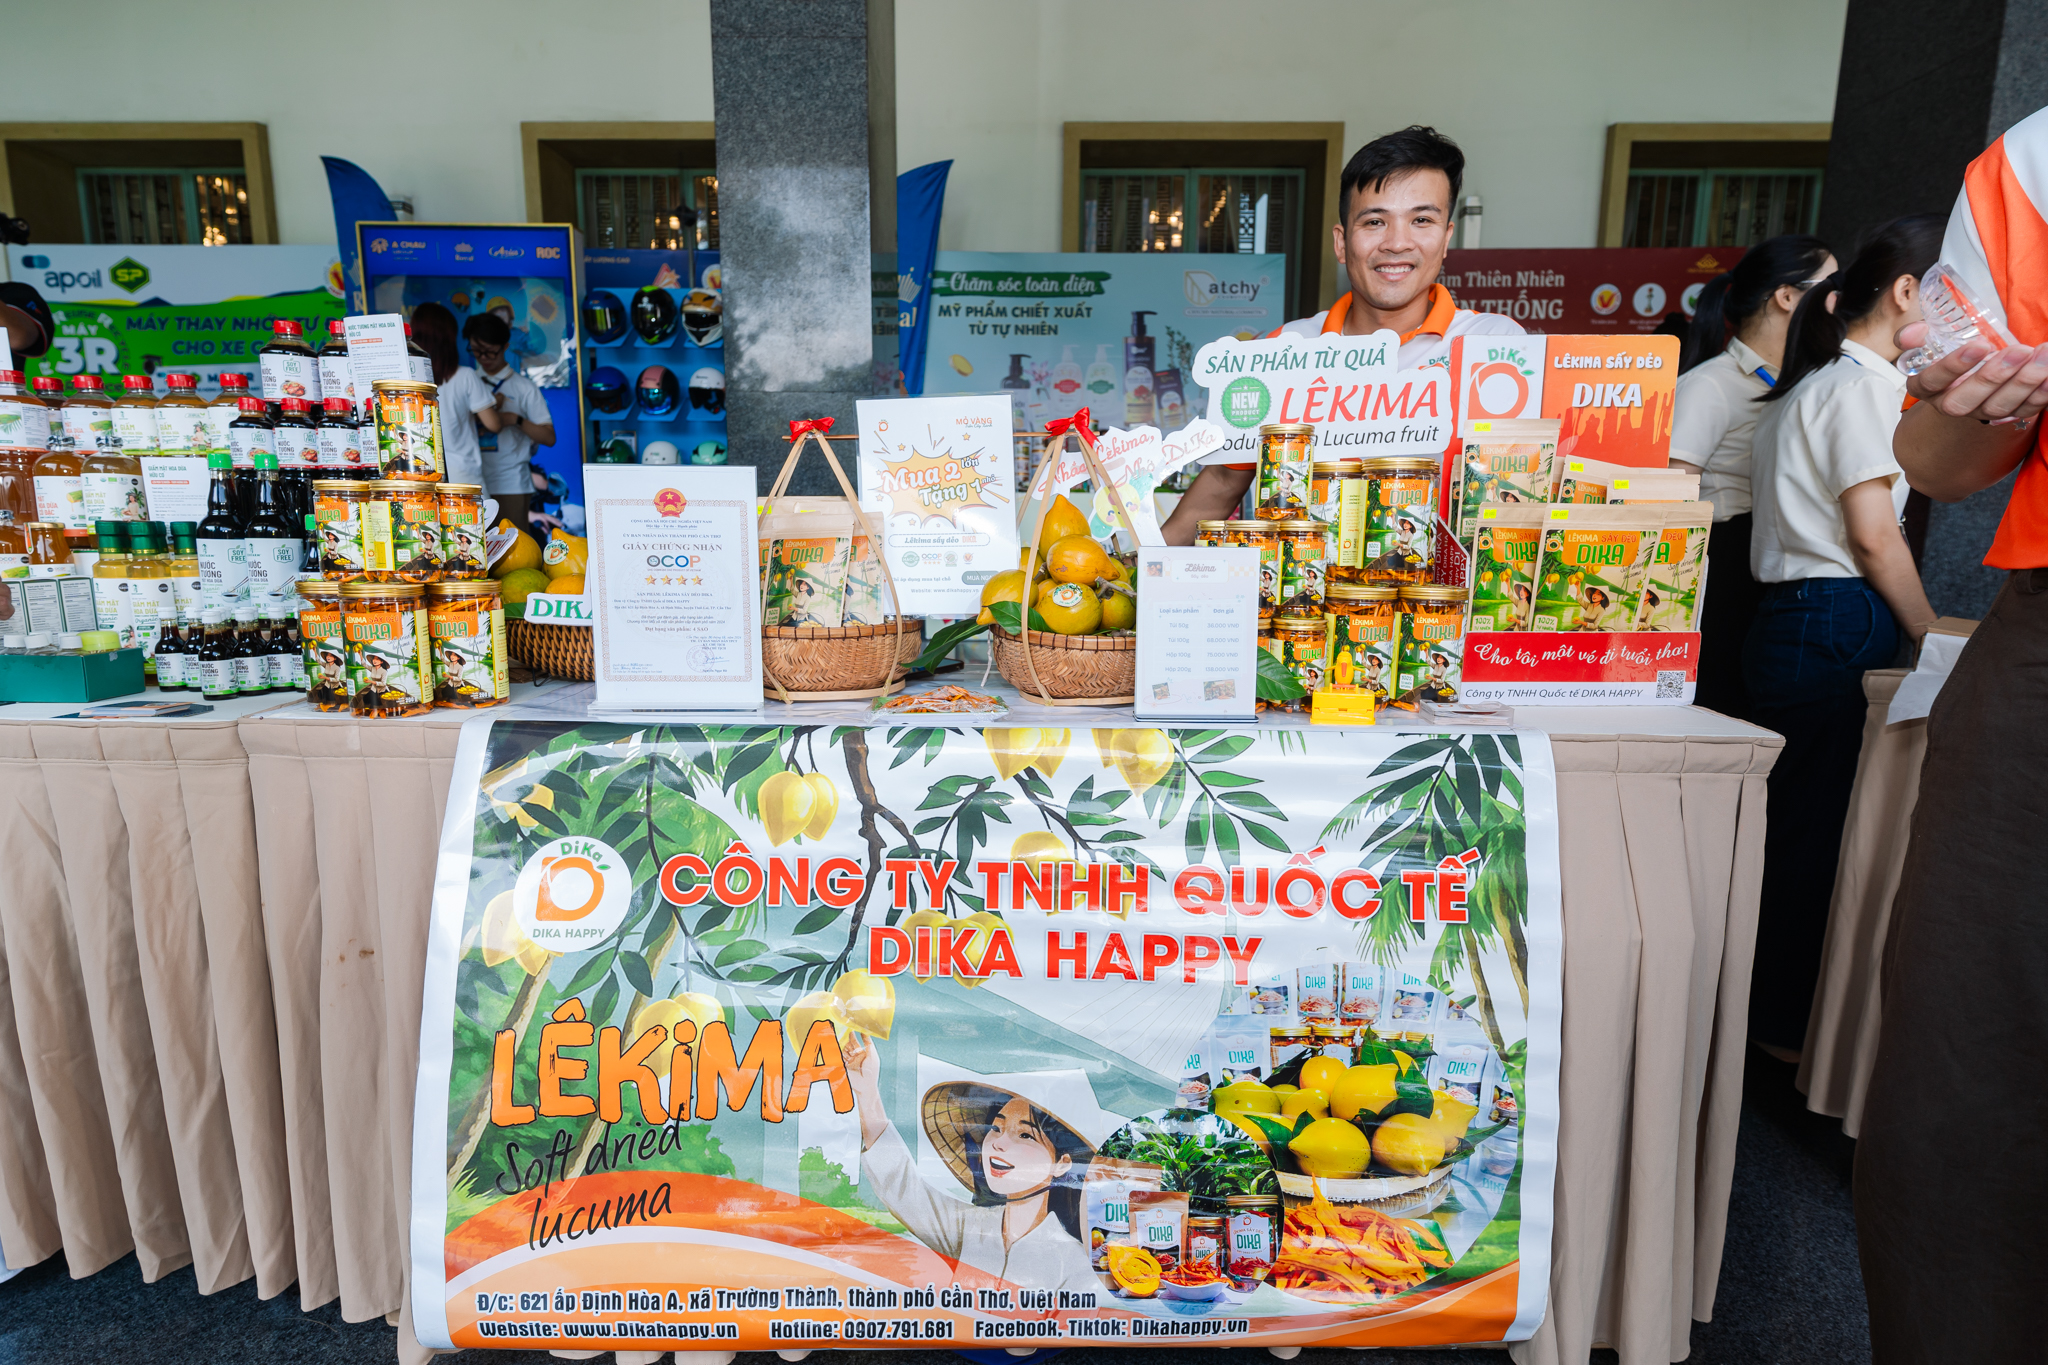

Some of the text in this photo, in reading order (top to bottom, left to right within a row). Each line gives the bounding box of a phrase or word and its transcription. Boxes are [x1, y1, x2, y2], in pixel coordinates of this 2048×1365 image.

[536, 247, 561, 259] ROC
[44, 269, 102, 294] apoil
[949, 272, 1097, 295] Chăm sóc toàn diện
[1465, 269, 1512, 288] Thiên
[1516, 268, 1566, 288] Nhiên
[938, 300, 1093, 318] MỸ PHẨM CHIẾT XUẤT
[62, 322, 98, 336] MÁY
[126, 312, 227, 331] MÁY THAY
[969, 320, 1059, 338] TỪ TỰ NHIÊN
[53, 337, 121, 376] 3R
[172, 340, 216, 355] CHO
[220, 340, 246, 355] XE
[1205, 342, 1388, 374] SẢN PHẨM TỪ QUẢ
[1488, 347, 1527, 367] DiKa
[1554, 351, 1663, 370] LÊKIMA SẤY DẺO
[1231, 391, 1260, 409] NEW
[1279, 376, 1439, 424] LÊKIMA
[1572, 383, 1643, 408] DIKA
[956, 416, 993, 425] MỎ VÀNG
[1324, 424, 1440, 447] Lucuma fruit
[961, 456, 980, 469] lớn
[1491, 454, 1529, 473] DIKA
[881, 460, 963, 493] Mua 2
[981, 474, 996, 484] nhỏ
[918, 477, 982, 509] Tặng 1
[1389, 489, 1422, 505] DIKA
[622, 541, 723, 552] GIẤY CHỨNG NHẬN
[785, 539, 807, 548] LÊKIMA
[1568, 533, 1599, 543] LÊKIMA
[790, 547, 824, 563] DIKA
[1504, 541, 1539, 562] DIKA
[1576, 543, 1625, 566] DIKA
[646, 555, 701, 568] OCOP
[1185, 563, 1216, 572] Lêkima
[1352, 618, 1374, 626] LÊKIMA
[1416, 616, 1439, 624] LÊKIMA
[1537, 616, 1555, 625] 100%
[353, 623, 391, 640] DIKA
[434, 621, 468, 638] DIKA
[1359, 626, 1389, 642] DIKA
[1423, 624, 1456, 640] DIKA
[1474, 642, 1689, 668] Cho tôi một vé đi tuổi thơ!
[1465, 688, 1644, 700] Công ty TNHH Quốc tế DIKA HAPPY
[560, 841, 603, 863] DiKa
[659, 841, 1481, 923] CÔNG TY TNHH QUỐC TẾ
[532, 928, 605, 939] DIKA HAPPY
[868, 926, 1265, 986] DIKA HAPPY
[1305, 975, 1326, 989] DIKA
[1352, 975, 1373, 990] DIKA
[1447, 1060, 1477, 1077] DIKA
[495, 1102, 687, 1198] Soft dried
[529, 1182, 673, 1252] lucuma
[1149, 1225, 1174, 1243] DIKA
[1236, 1233, 1262, 1250] DIKA
[477, 1283, 1097, 1316] Đ/c: 621 ấp Định Hòa A, xã Trường Thành, thành phố Cần Thơ, Việt Nam
[478, 1318, 1249, 1341] Website: www.Dikahappy.vn Hotline: 0907.791.681 Facebook, Tiktok: Dikahappy.vn
